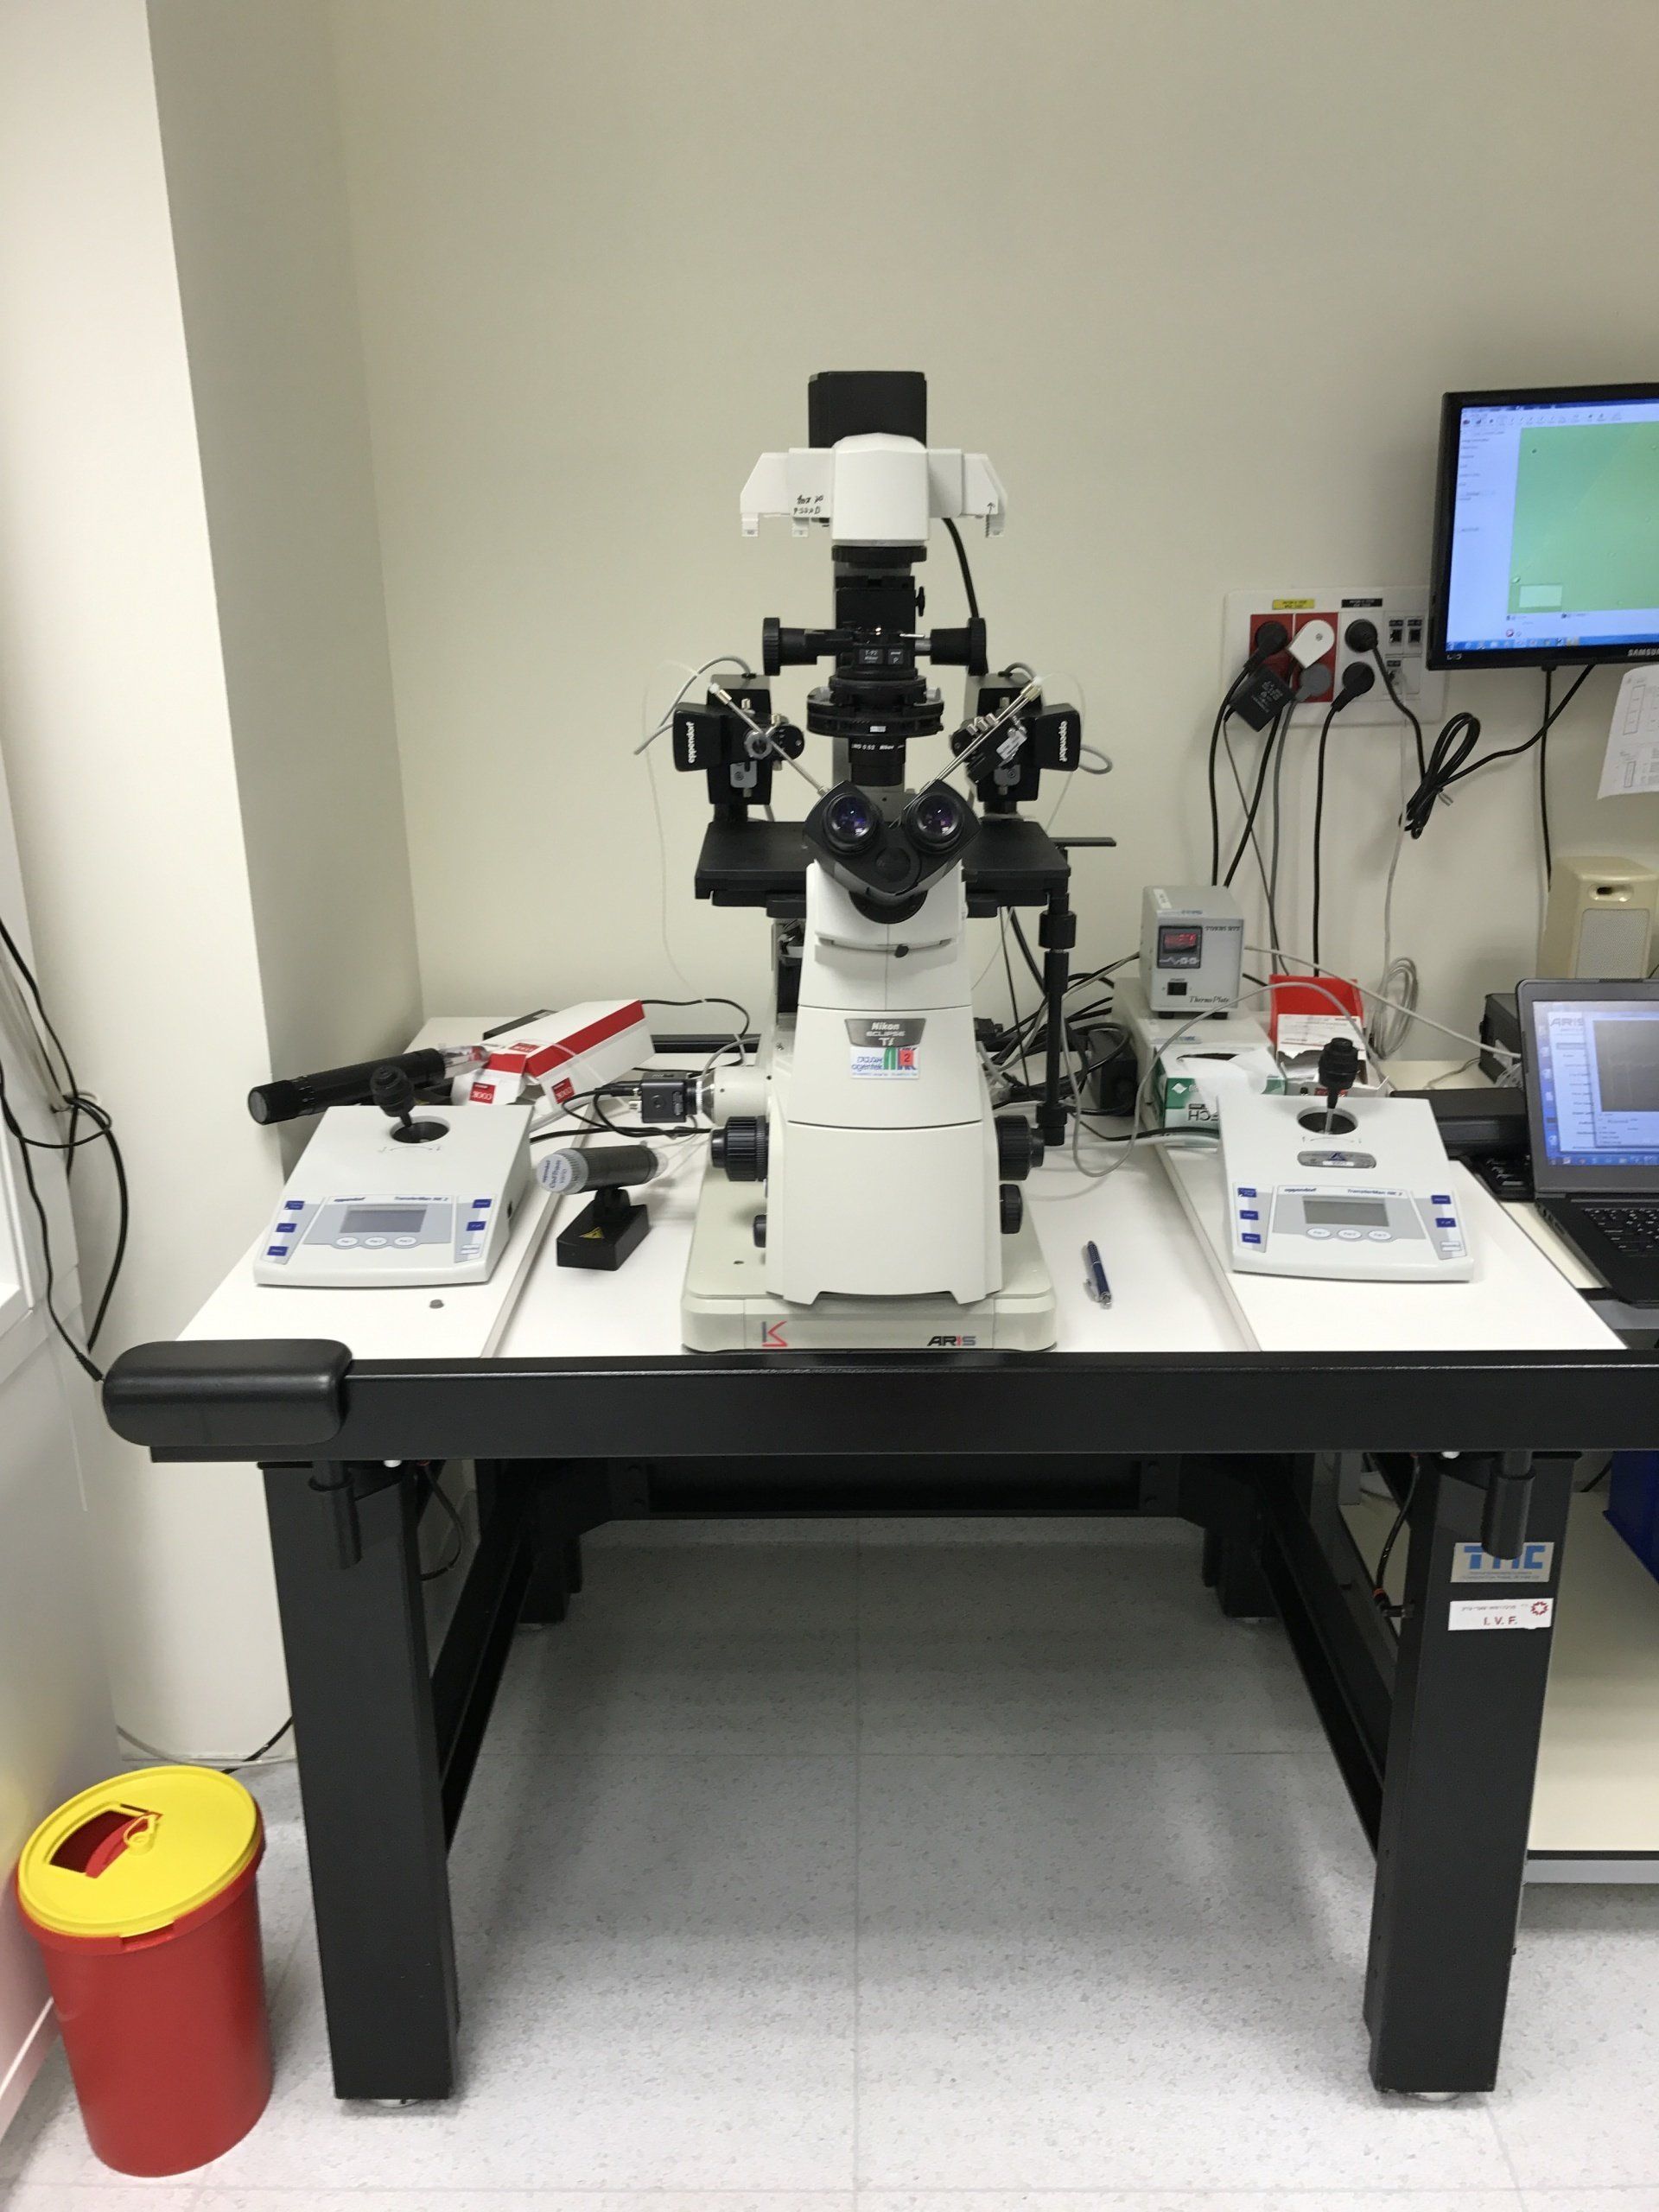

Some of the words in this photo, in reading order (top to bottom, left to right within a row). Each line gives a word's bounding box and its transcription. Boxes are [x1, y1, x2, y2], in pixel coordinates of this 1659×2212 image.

[685, 721, 697, 764] eppendorf
[1058, 720, 1068, 762] eppendorf
[871, 1021, 900, 1030] Nikon
[878, 1037, 896, 1046] Ti
[904, 1052, 911, 1063] 2
[927, 1335, 976, 1346] ARIS
